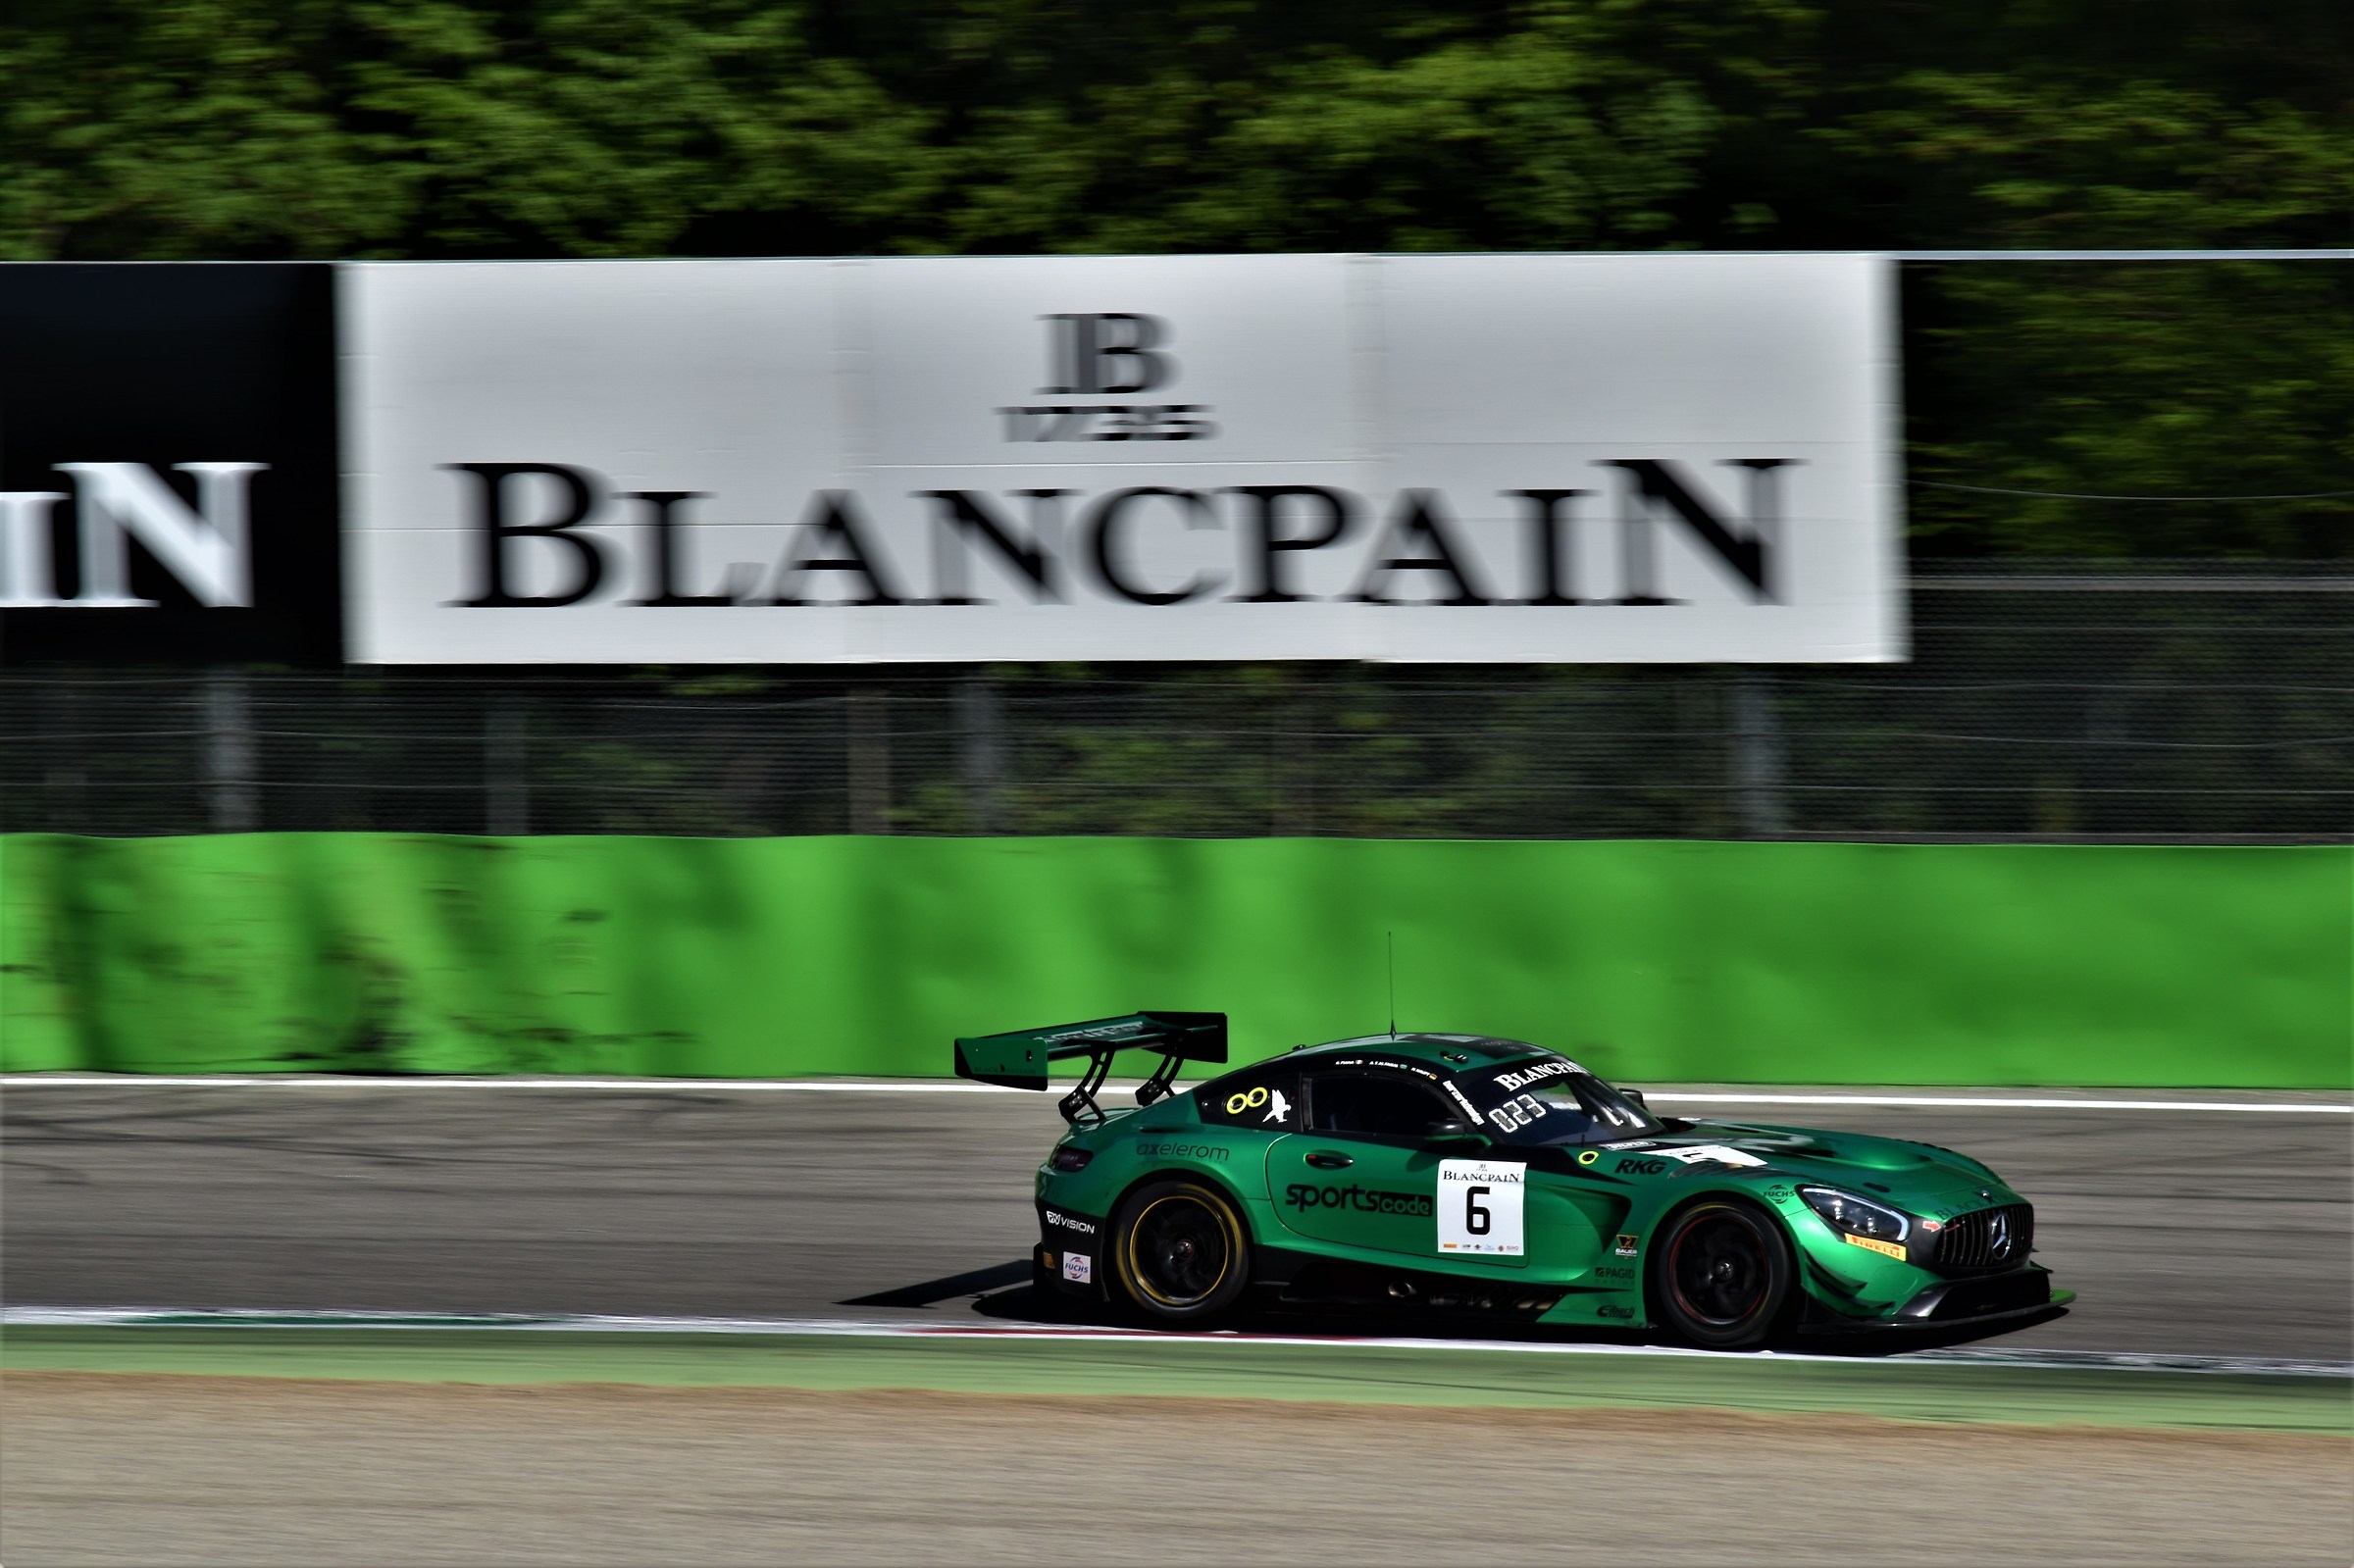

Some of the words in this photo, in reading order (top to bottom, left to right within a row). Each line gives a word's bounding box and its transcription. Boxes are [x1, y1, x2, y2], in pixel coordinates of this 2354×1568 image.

[438, 458, 1804, 609] BLANCPAIN
[1136, 1142, 1230, 1161] axelerom
[1614, 1158, 1667, 1175] RKG
[1443, 1170, 1520, 1183] BLANCPAIN
[1765, 1189, 1796, 1198] FUCHS
[1466, 1186, 1491, 1236] 6
[1061, 1217, 1096, 1234] VISION
[1851, 1236, 1900, 1258] PIRELLI
[1065, 1262, 1089, 1274] FUCHS
[1606, 1268, 1635, 1279] PAGID
